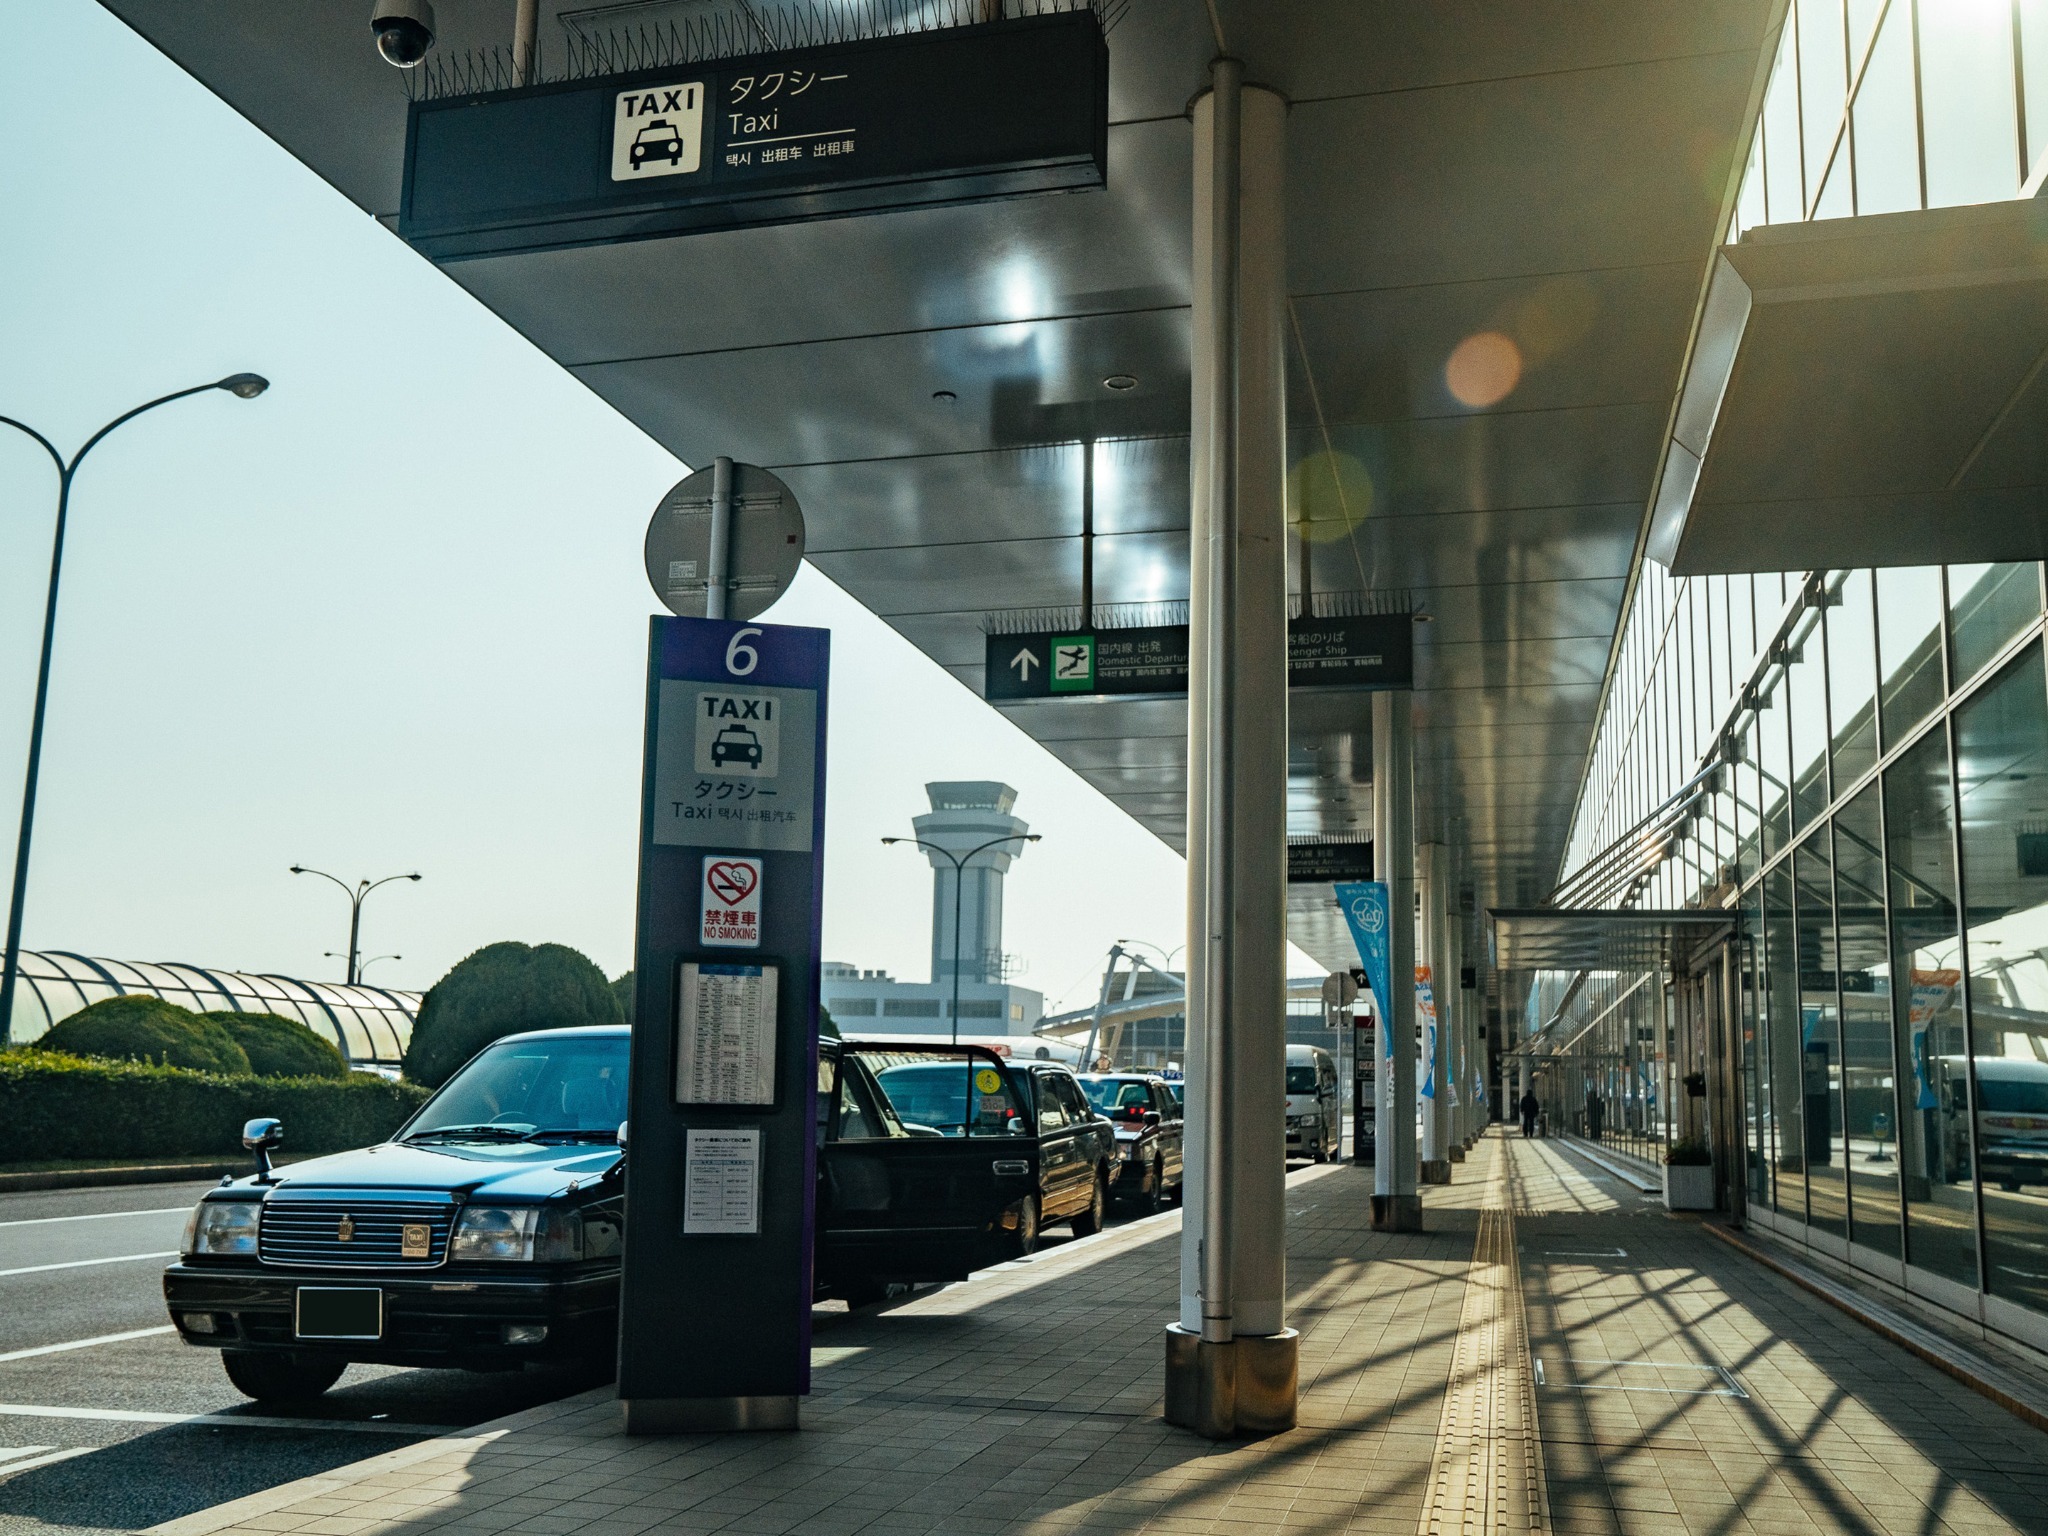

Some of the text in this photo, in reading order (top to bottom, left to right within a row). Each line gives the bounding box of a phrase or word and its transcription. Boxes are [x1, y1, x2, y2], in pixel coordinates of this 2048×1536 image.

[730, 70, 848, 104] タクシー
[623, 88, 695, 117] TAXI
[728, 108, 779, 135] Taxi
[726, 140, 855, 167] 택시 出租车 出租車
[1098, 641, 1161, 655] 国内線 出発
[1288, 631, 1345, 645] 客船のりば
[725, 627, 764, 676] 6
[1098, 655, 1188, 665] Domestic Departur
[1325, 646, 1347, 656] Ship
[702, 697, 771, 721] TAXI
[694, 780, 778, 800] タクシー
[672, 802, 797, 823] Taxi 택시 出租汽车
[705, 909, 757, 927] 禁煙車
[704, 926, 757, 940] NO SMOKING
